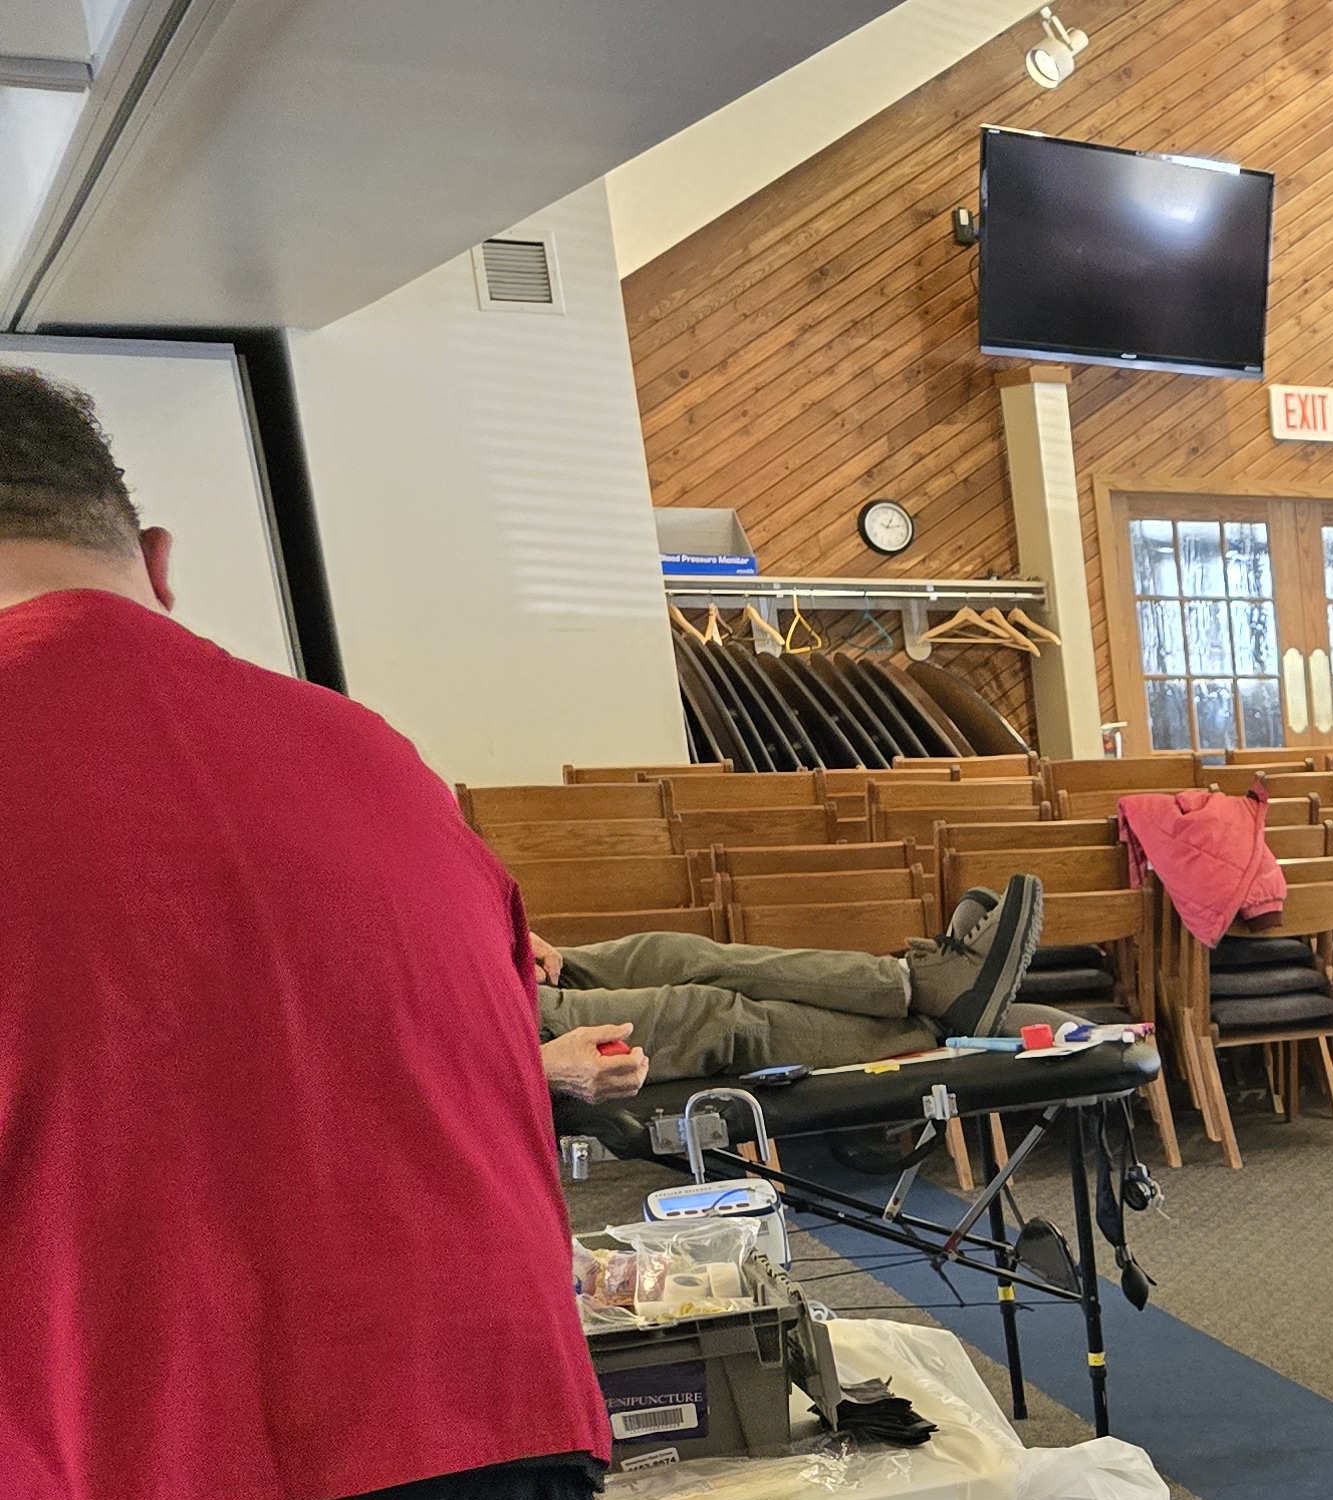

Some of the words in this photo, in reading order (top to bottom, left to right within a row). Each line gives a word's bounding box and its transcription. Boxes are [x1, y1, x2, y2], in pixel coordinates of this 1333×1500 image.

[1284, 392, 1328, 431] EXIT
[681, 554, 718, 565] Pressure
[718, 555, 750, 566] Monitor
[605, 1392, 704, 1409] ENIPUNCTURE
